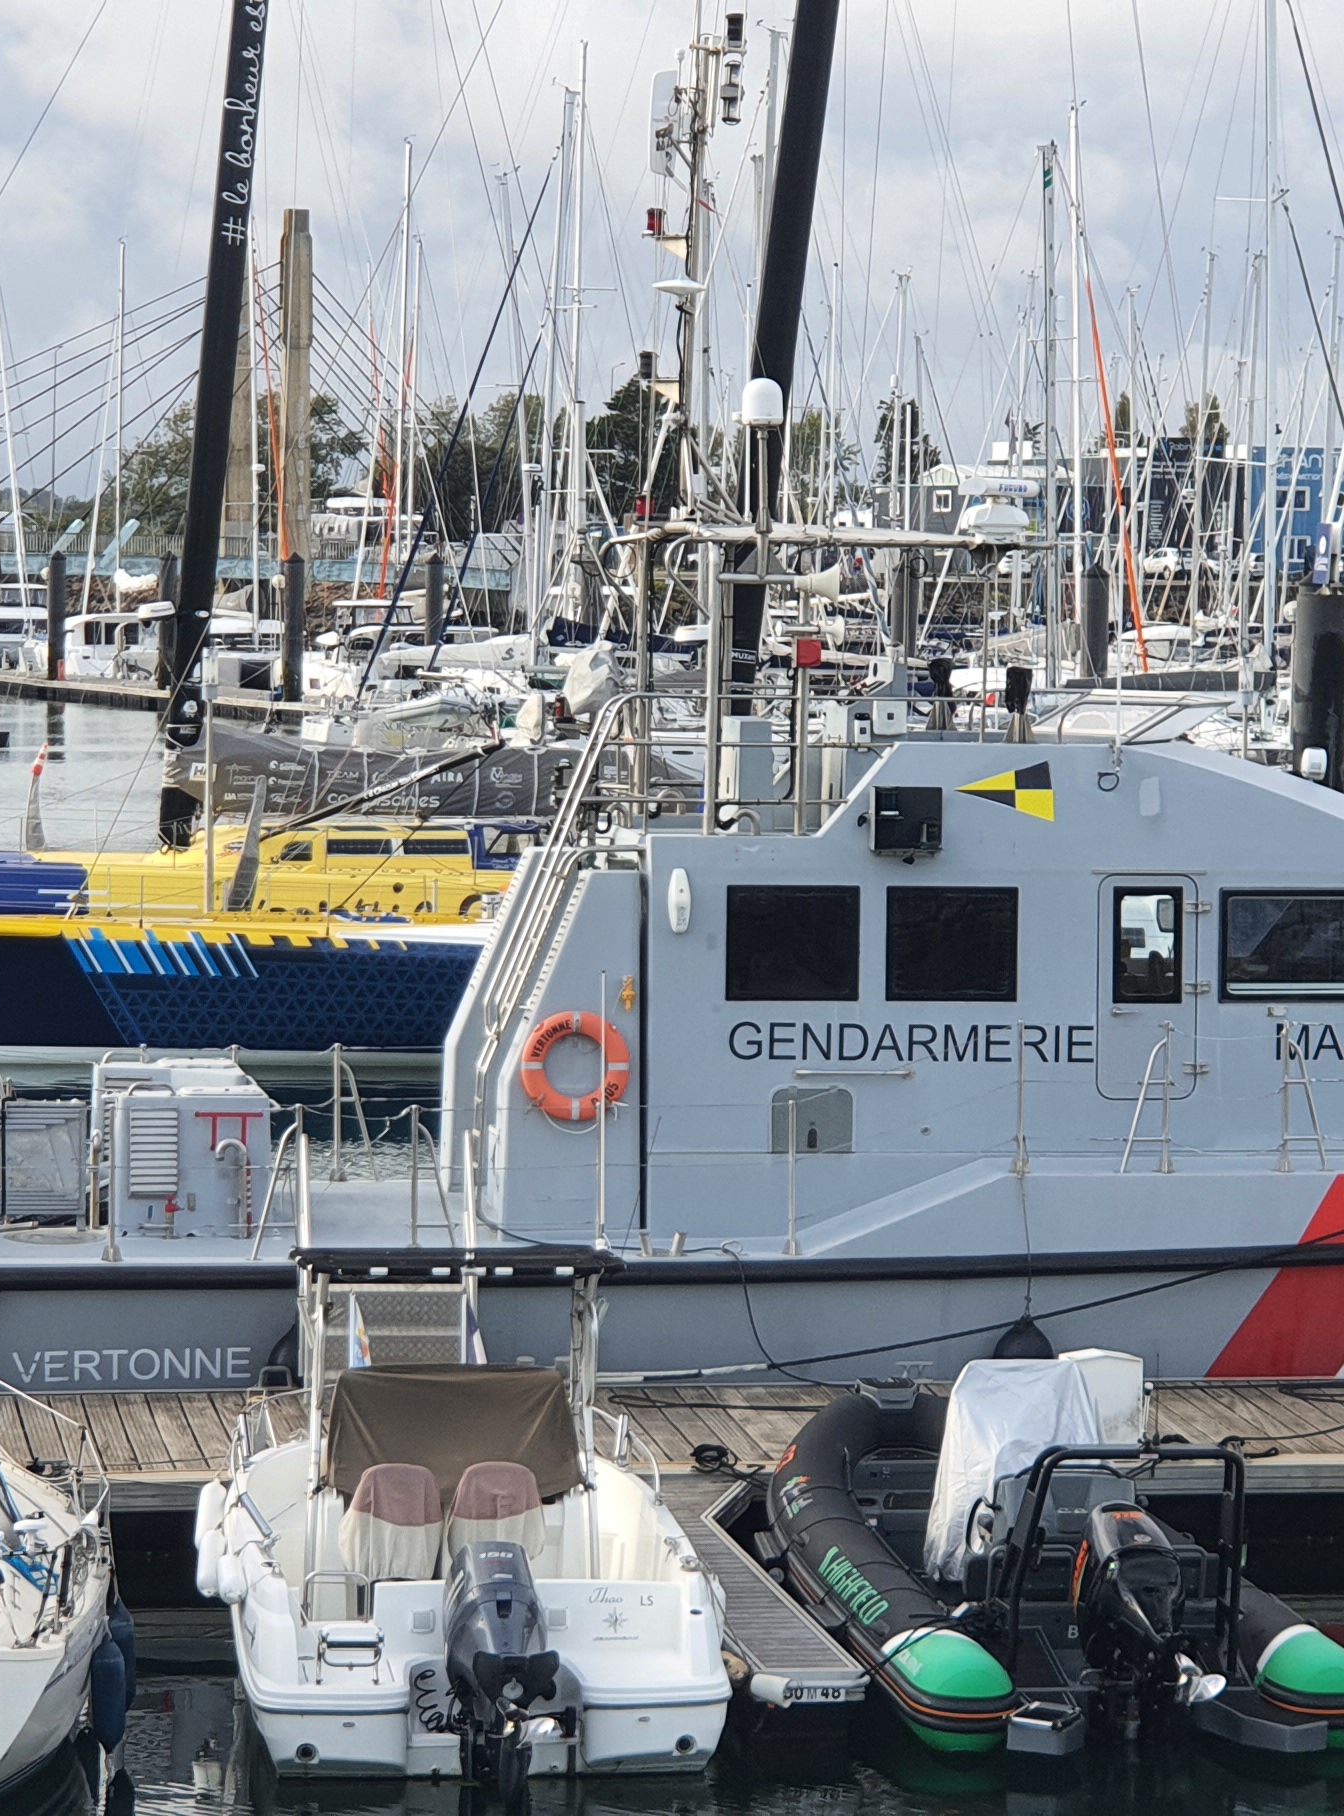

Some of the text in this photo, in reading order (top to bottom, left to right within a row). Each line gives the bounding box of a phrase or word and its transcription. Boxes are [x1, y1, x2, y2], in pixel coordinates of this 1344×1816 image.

[224, 43, 261, 169] bonheur
[222, 178, 249, 205] le
[530, 1019, 572, 1059] VERTONNE
[728, 1021, 1095, 1064] GENDARMERIE
[12, 1346, 253, 1384] VERTONNE
[640, 1595, 654, 1606] LS
